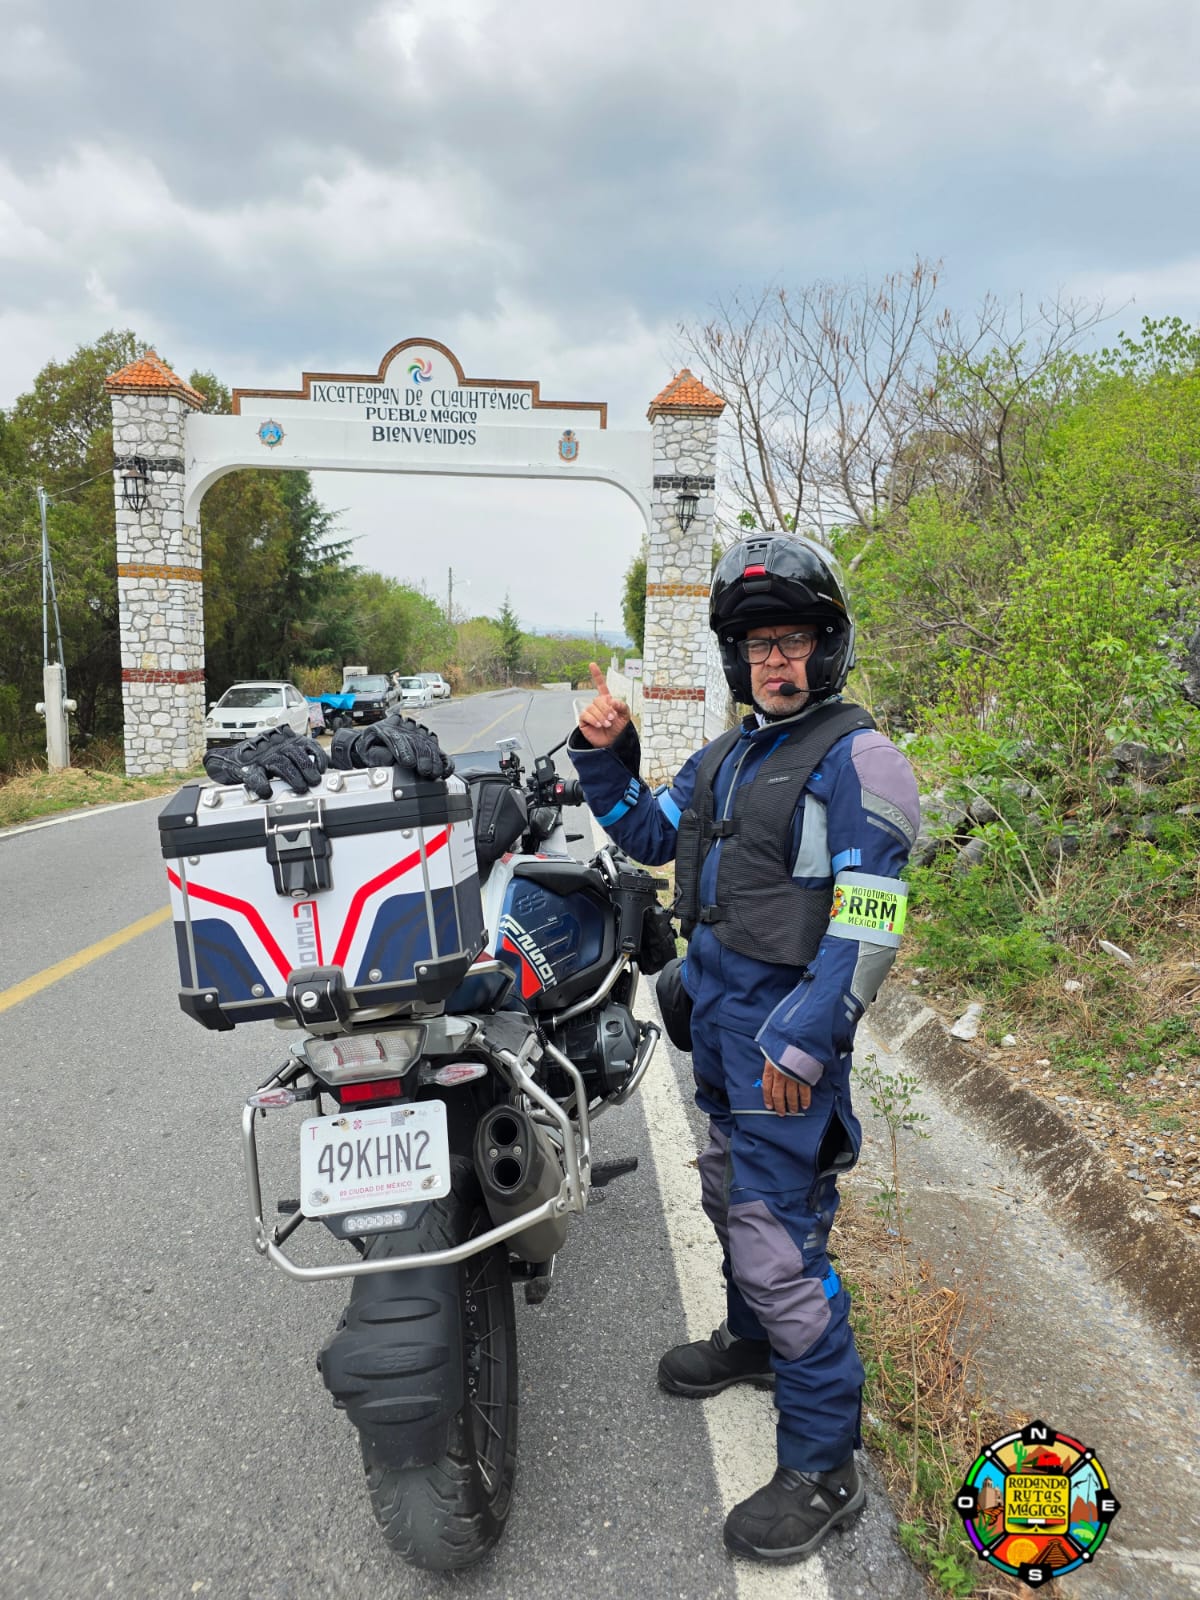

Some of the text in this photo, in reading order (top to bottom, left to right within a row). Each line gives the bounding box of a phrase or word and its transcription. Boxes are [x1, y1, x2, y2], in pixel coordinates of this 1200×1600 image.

[852, 887, 898, 903] MOTOTURISTA
[849, 896, 897, 922] RRM
[309, 1127, 318, 1140] T
[318, 1130, 431, 1183] 49KHN2
[348, 1185, 374, 1196] CIUDAD
[375, 1184, 385, 1192] DE
